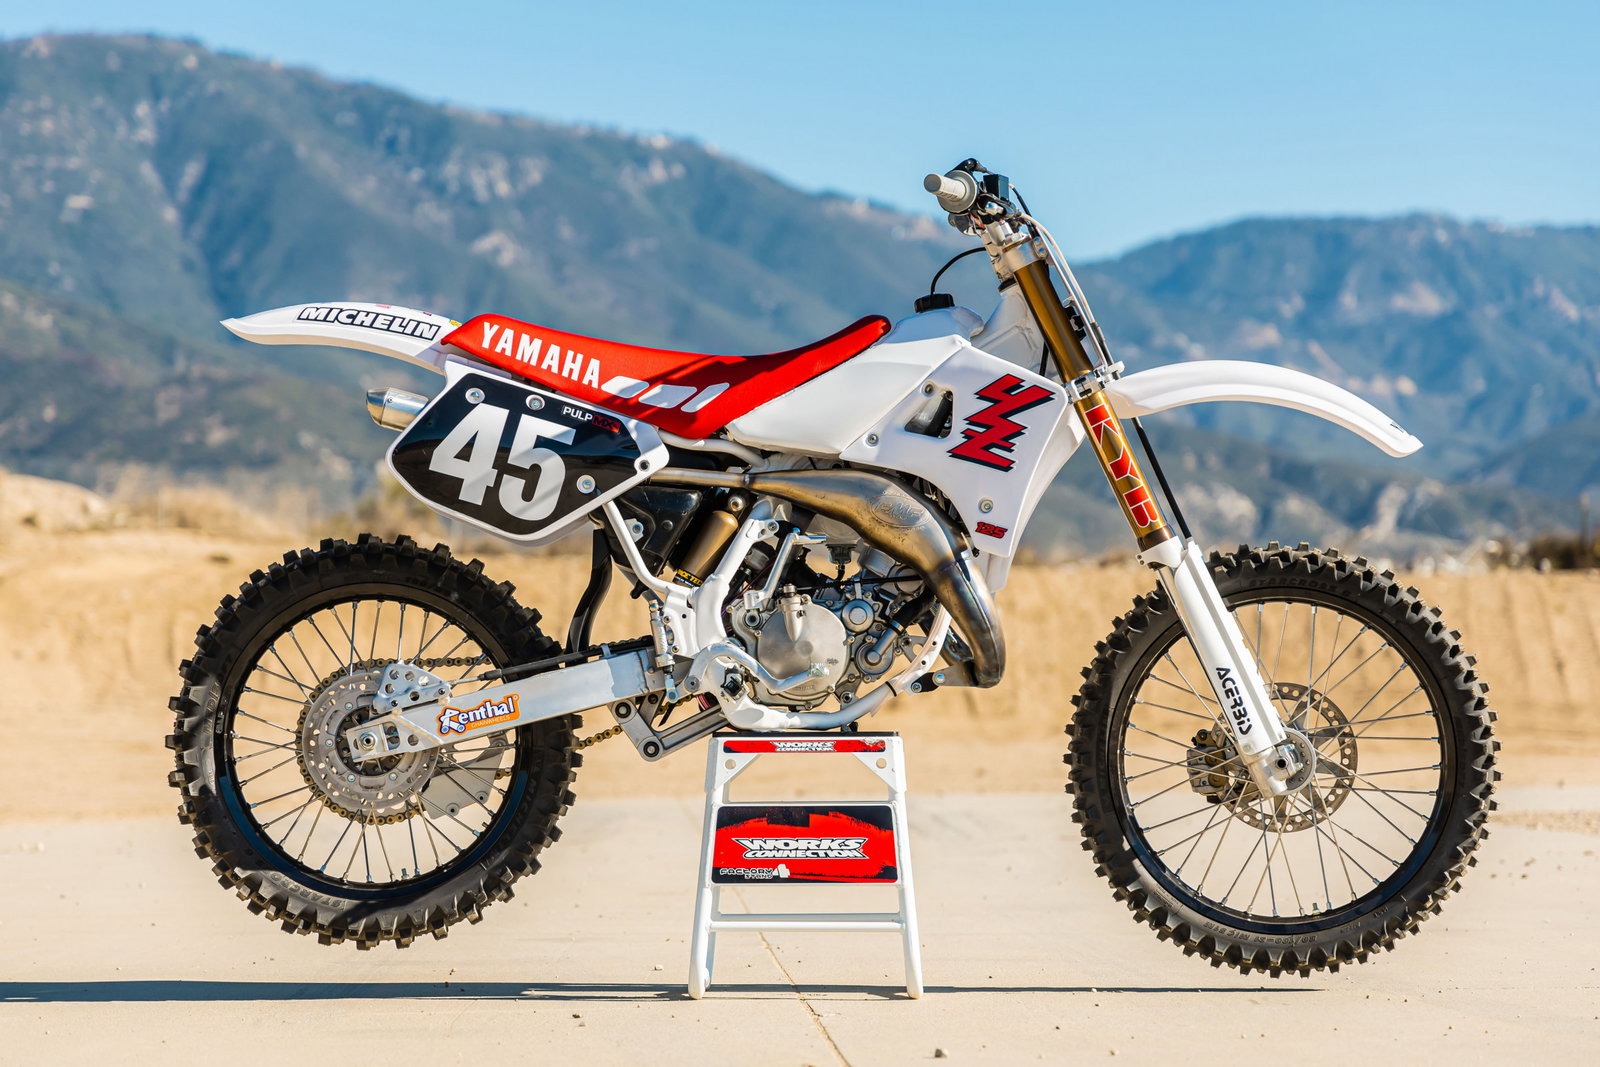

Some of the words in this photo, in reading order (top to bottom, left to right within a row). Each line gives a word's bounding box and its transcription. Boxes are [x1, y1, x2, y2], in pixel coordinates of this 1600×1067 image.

[296, 307, 441, 341] MICHELIN
[482, 321, 601, 389] YAMAHA
[429, 403, 577, 521] 45
[1084, 403, 1159, 527] KYB
[975, 521, 1008, 539] 125
[439, 696, 515, 735] Renthal
[1215, 667, 1252, 735] ACERBIS
[471, 715, 511, 728] CHAINWHEELS
[733, 838, 868, 850] WORKS
[743, 849, 870, 859] CONNECTION
